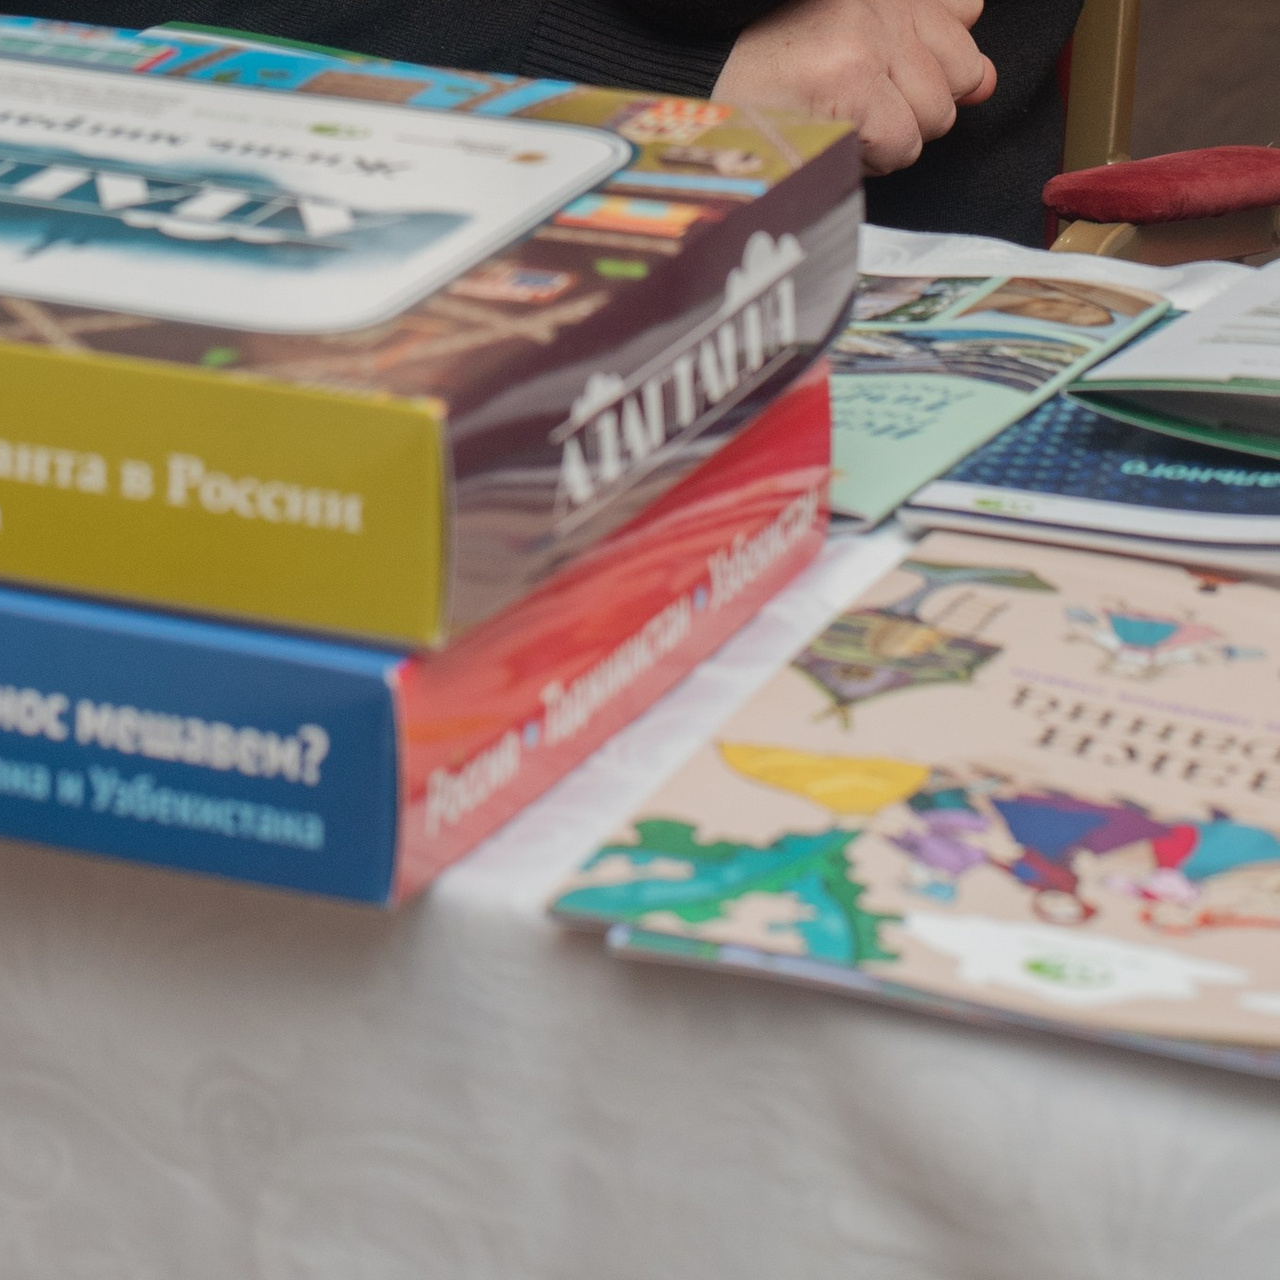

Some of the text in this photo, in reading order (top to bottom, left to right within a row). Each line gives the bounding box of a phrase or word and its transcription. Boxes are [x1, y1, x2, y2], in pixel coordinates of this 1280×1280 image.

[122, 458, 153, 499] в
[166, 451, 365, 534] России
[75, 699, 330, 785] мешавем?
[56, 767, 85, 803] и
[89, 765, 326, 850] Узбекистана
